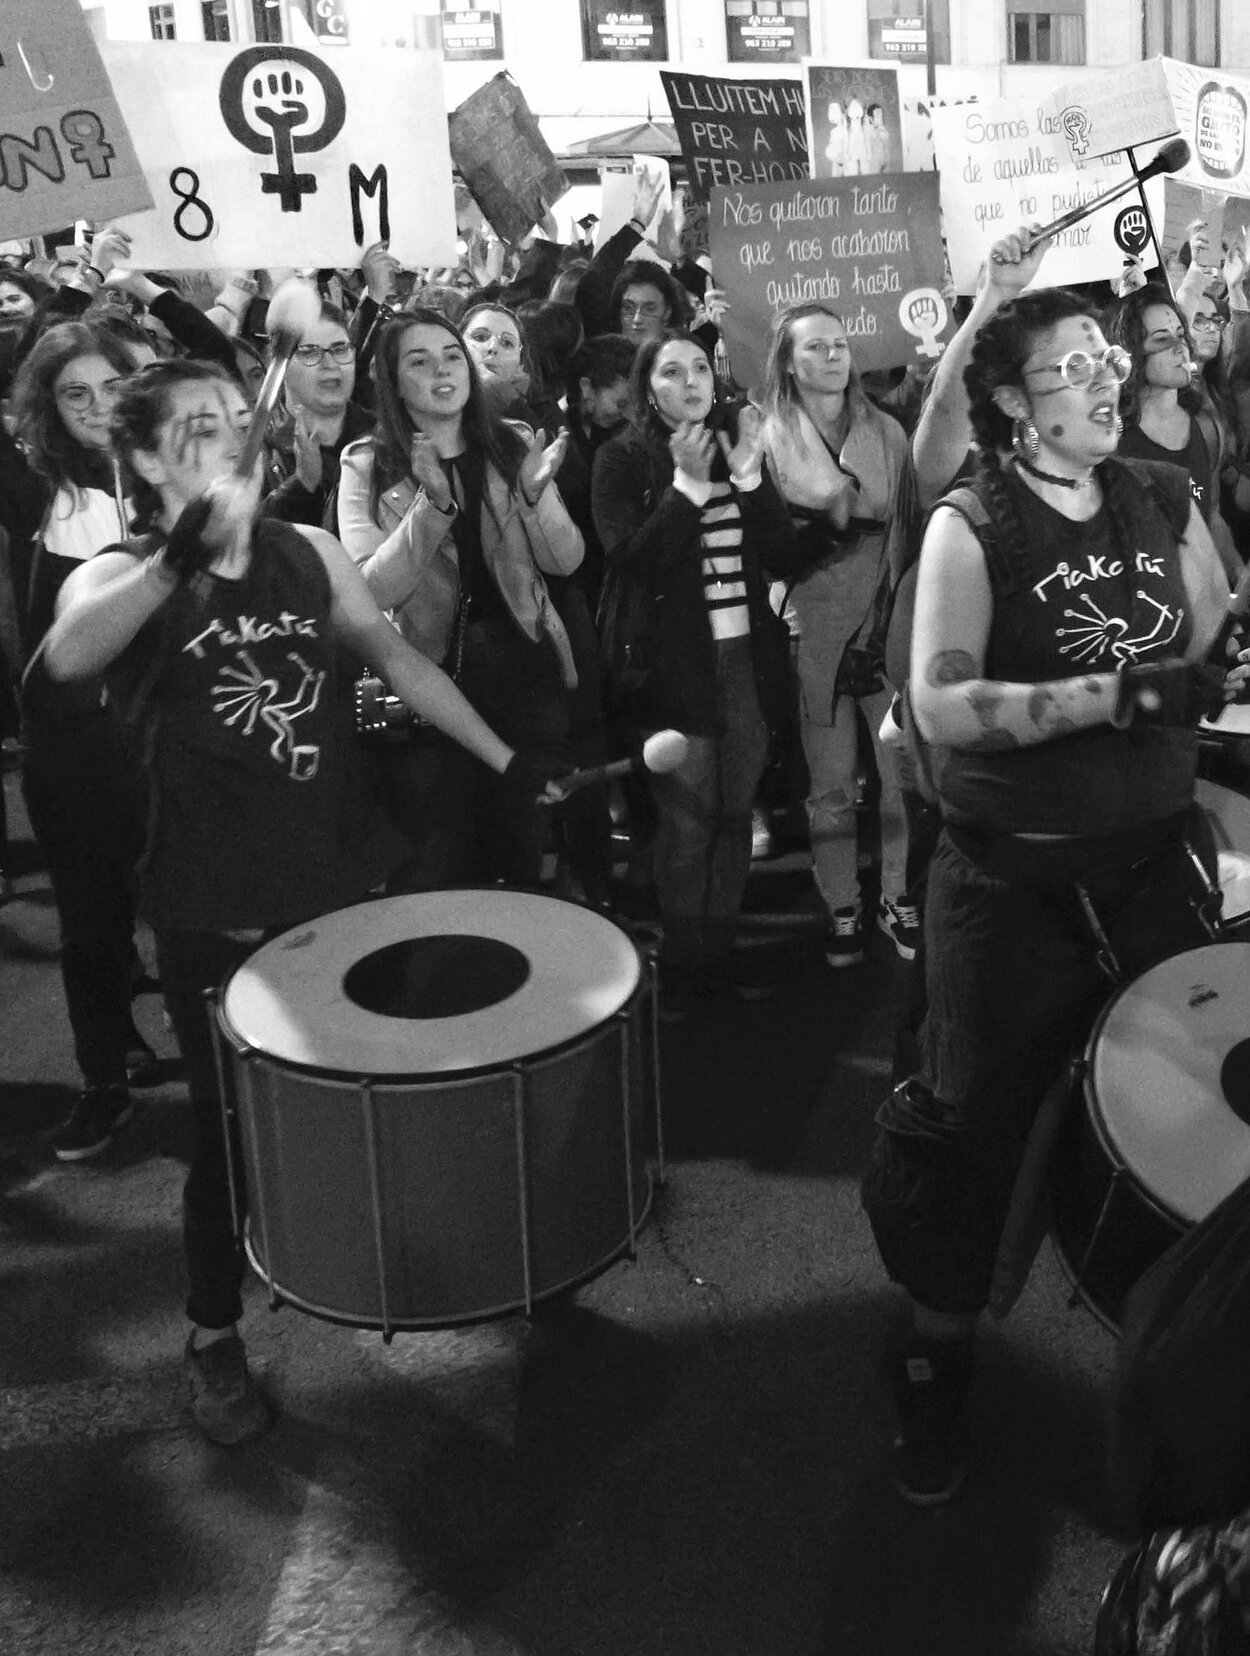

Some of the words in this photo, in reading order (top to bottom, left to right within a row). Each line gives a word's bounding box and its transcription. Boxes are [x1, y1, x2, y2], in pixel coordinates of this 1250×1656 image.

[671, 80, 780, 116] LLUITEM
[691, 121, 738, 150] PER
[753, 127, 771, 151] A
[786, 127, 808, 152] N
[964, 113, 1029, 144] Somos
[963, 154, 983, 184] de
[992, 146, 1059, 188] aquellas
[168, 166, 214, 242] 8
[723, 192, 763, 226] Nos
[769, 191, 840, 231] quitaron
[974, 198, 1004, 232] que
[739, 240, 775, 274] que
[787, 236, 823, 261] nos
[832, 228, 911, 258] acabaron
[851, 264, 903, 295] hasta
